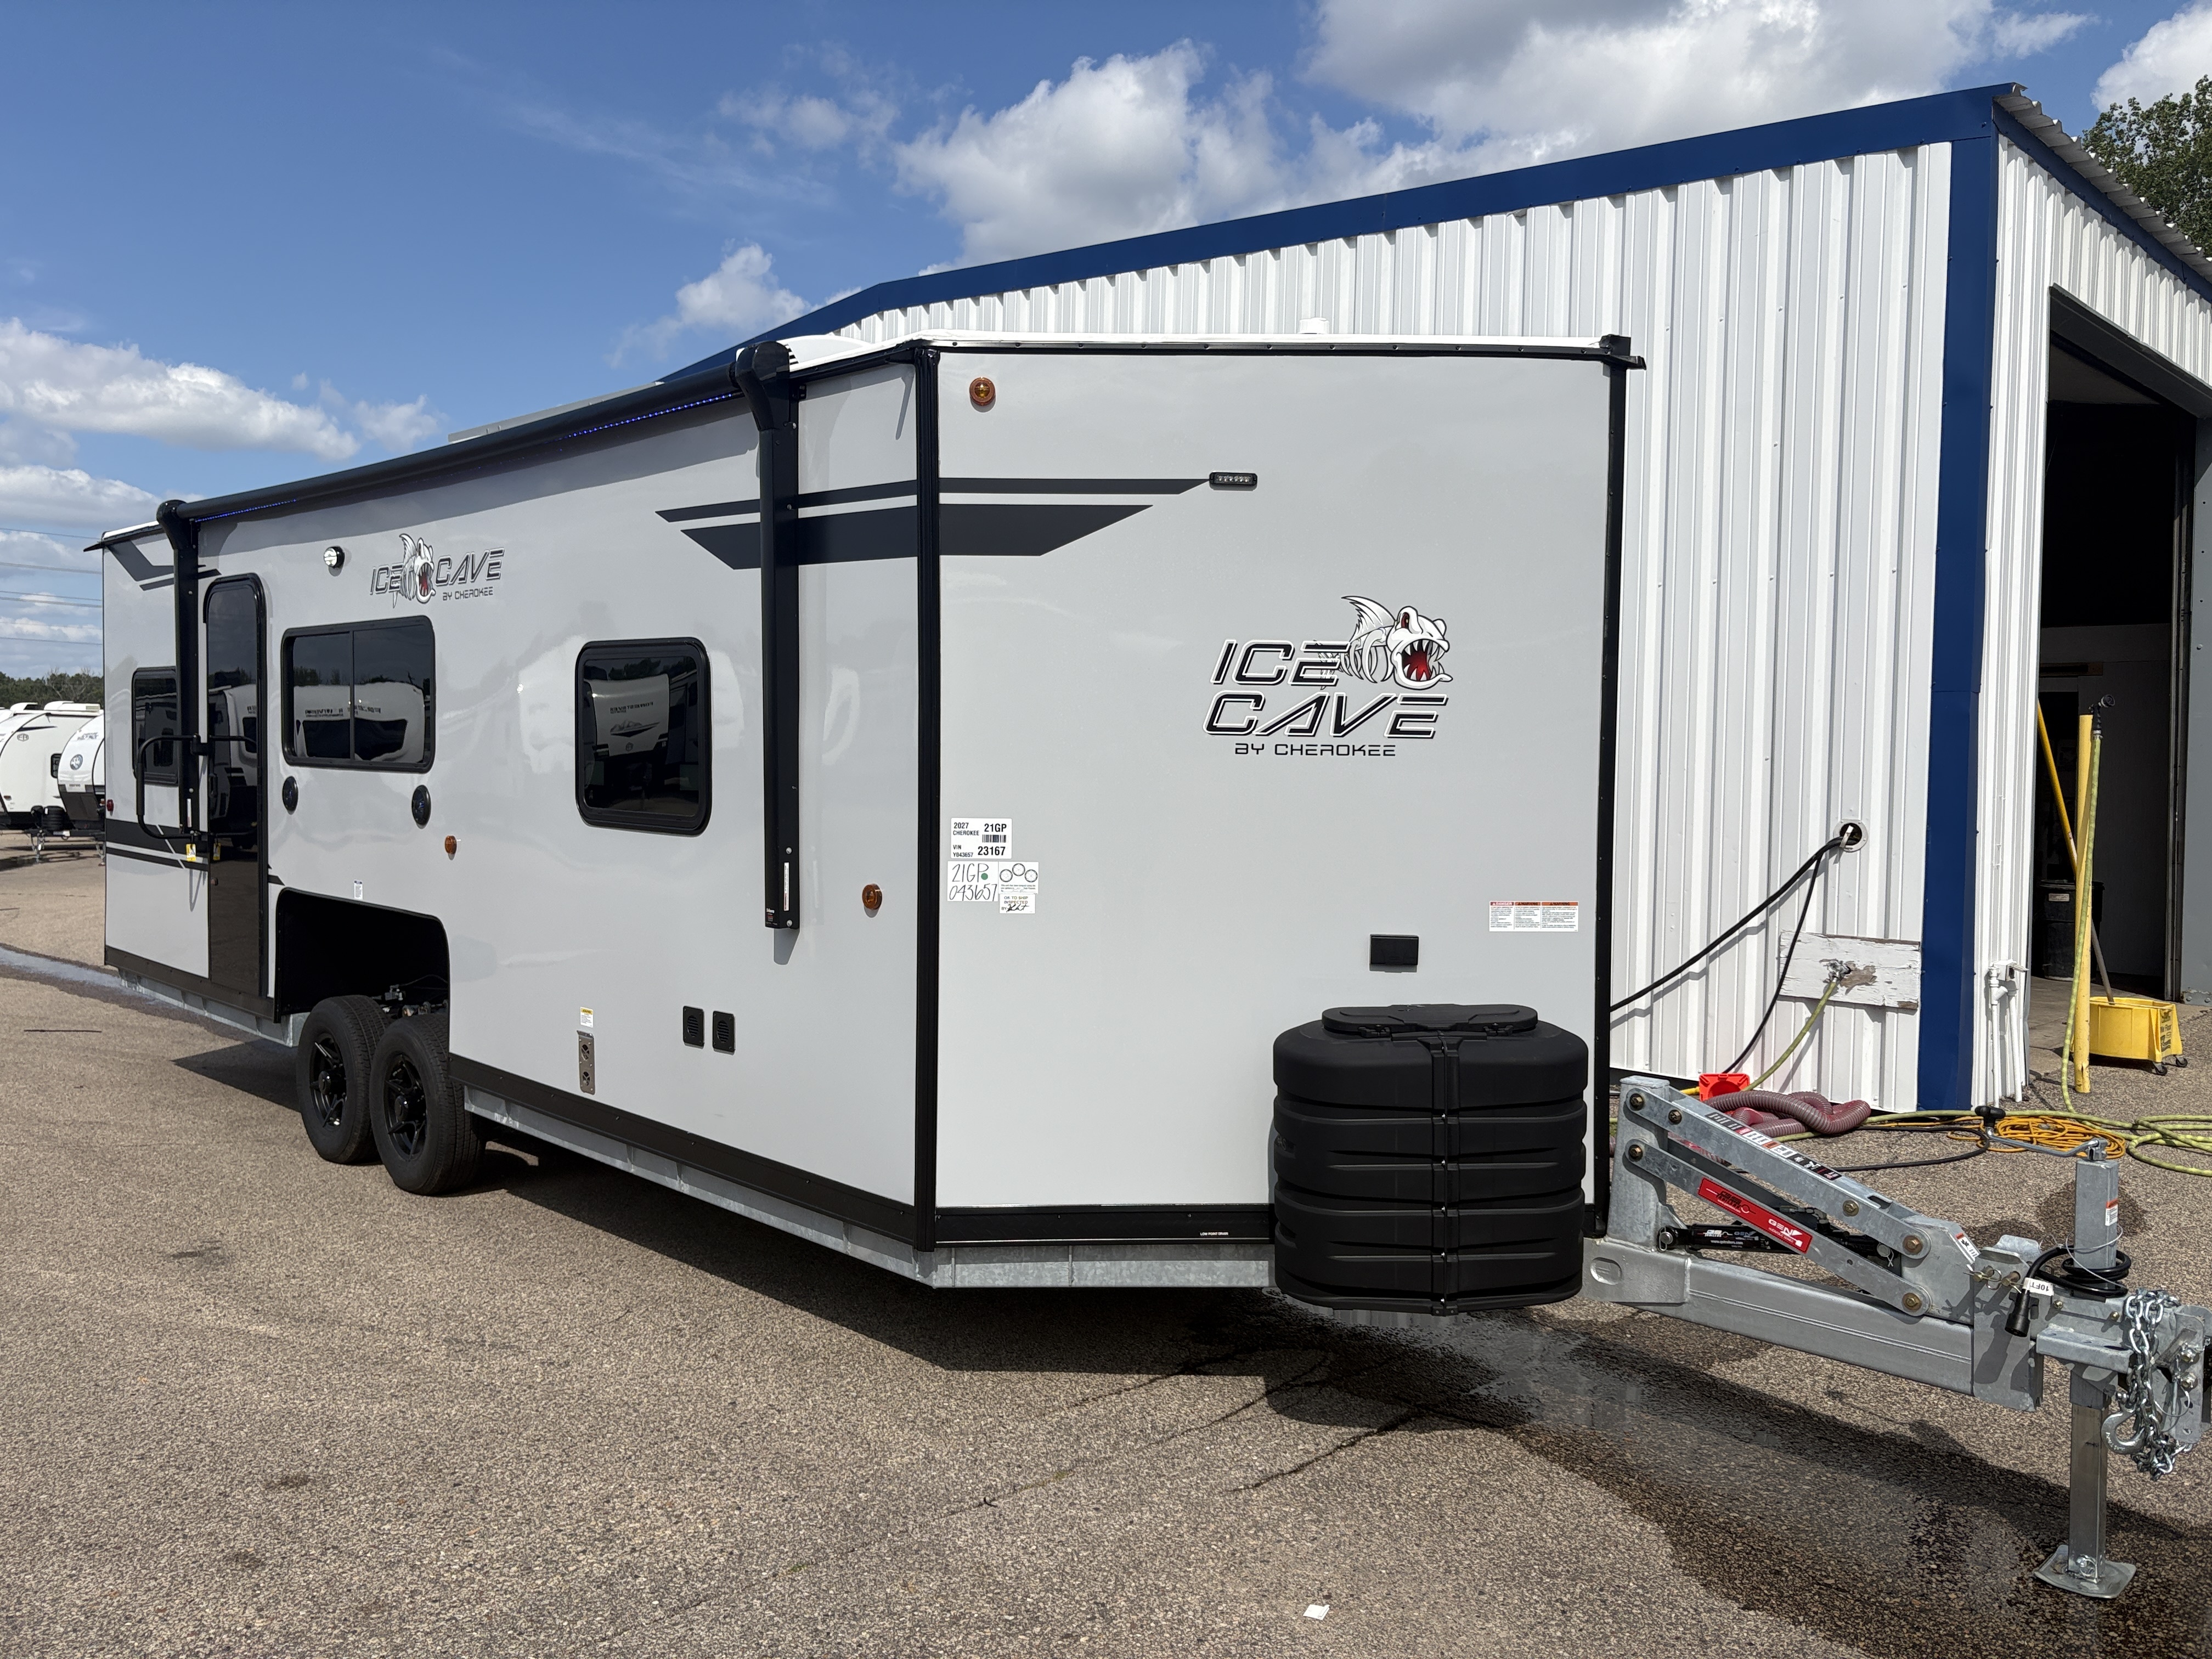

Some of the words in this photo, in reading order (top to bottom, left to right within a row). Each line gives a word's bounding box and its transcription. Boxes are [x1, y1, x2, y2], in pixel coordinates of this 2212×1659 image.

[370, 562, 404, 595] ICE
[435, 548, 505, 586] CAVE
[443, 591, 452, 601] BY
[455, 586, 494, 600] CHEROKEE
[1210, 639, 1352, 686] ICE
[1203, 690, 1448, 738] CAVE
[1235, 743, 1265, 755] BY
[1274, 743, 1396, 757] CHEROKEE
[984, 823, 1007, 832] 21GP
[978, 846, 1006, 856] 23167
[952, 863, 989, 883] 21GP
[949, 883, 997, 901] 043657
[2030, 1282, 2049, 1291] 10FT
